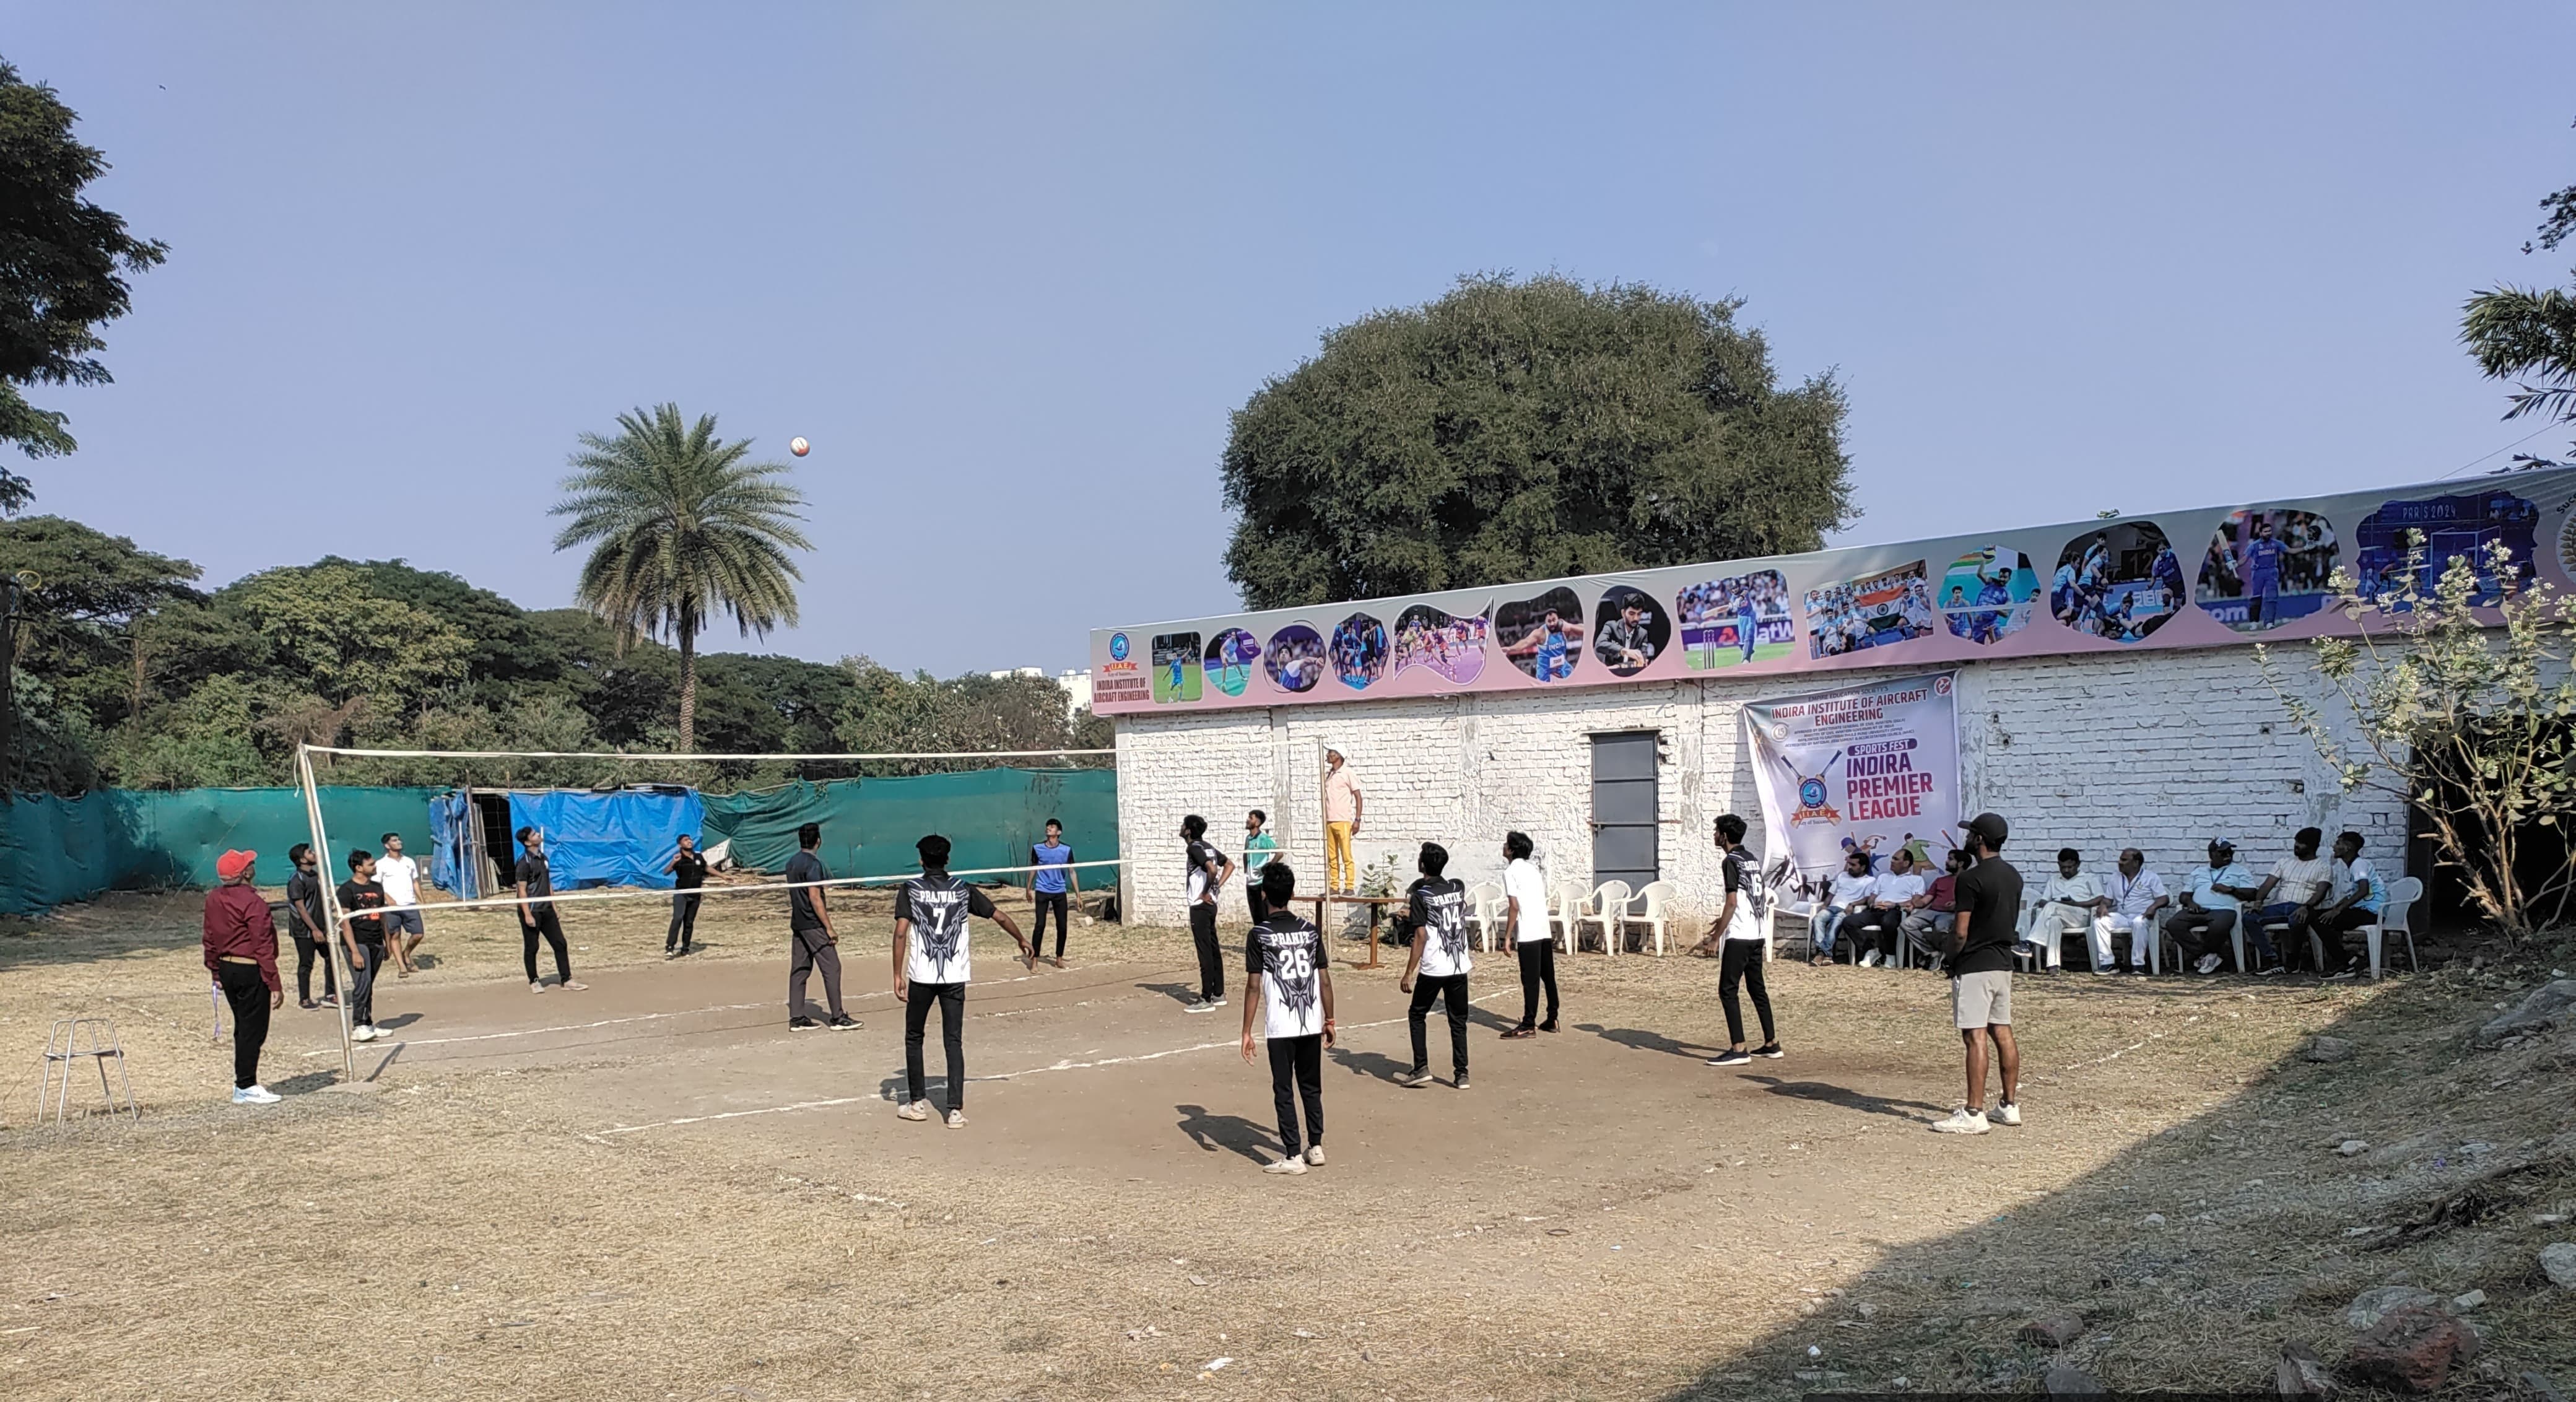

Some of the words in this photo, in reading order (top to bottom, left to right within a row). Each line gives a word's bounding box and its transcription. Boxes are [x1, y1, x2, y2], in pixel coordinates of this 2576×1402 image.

[2430, 503, 2456, 518] 2024
[2258, 547, 2276, 556] INDIA
[1097, 680, 1113, 690] INDIRA
[1114, 677, 1139, 689] INSTITUTE
[1139, 677, 1146, 688] OF
[1094, 691, 1116, 703] AIRCRAFT
[1118, 689, 1150, 702] ENGINEERING
[1772, 705, 1805, 719] INDIRA
[1808, 698, 1858, 715] INSTITUTE
[1861, 696, 1874, 708] OF
[1876, 689, 1928, 706] AIRCRAFT
[1815, 708, 1884, 726] ENGINEERING
[1854, 742, 1887, 755] SPORTS
[1889, 739, 1910, 751] FEST
[1847, 752, 1912, 778] INDIRA
[1847, 772, 1934, 799] PREMIER
[1848, 796, 1921, 821] LEAGUE
[919, 890, 958, 903] PRAJWAL
[1432, 892, 1463, 907] PRATIK
[933, 908, 946, 934] 7
[1442, 905, 1462, 931] 04
[1279, 948, 1311, 980] 26
